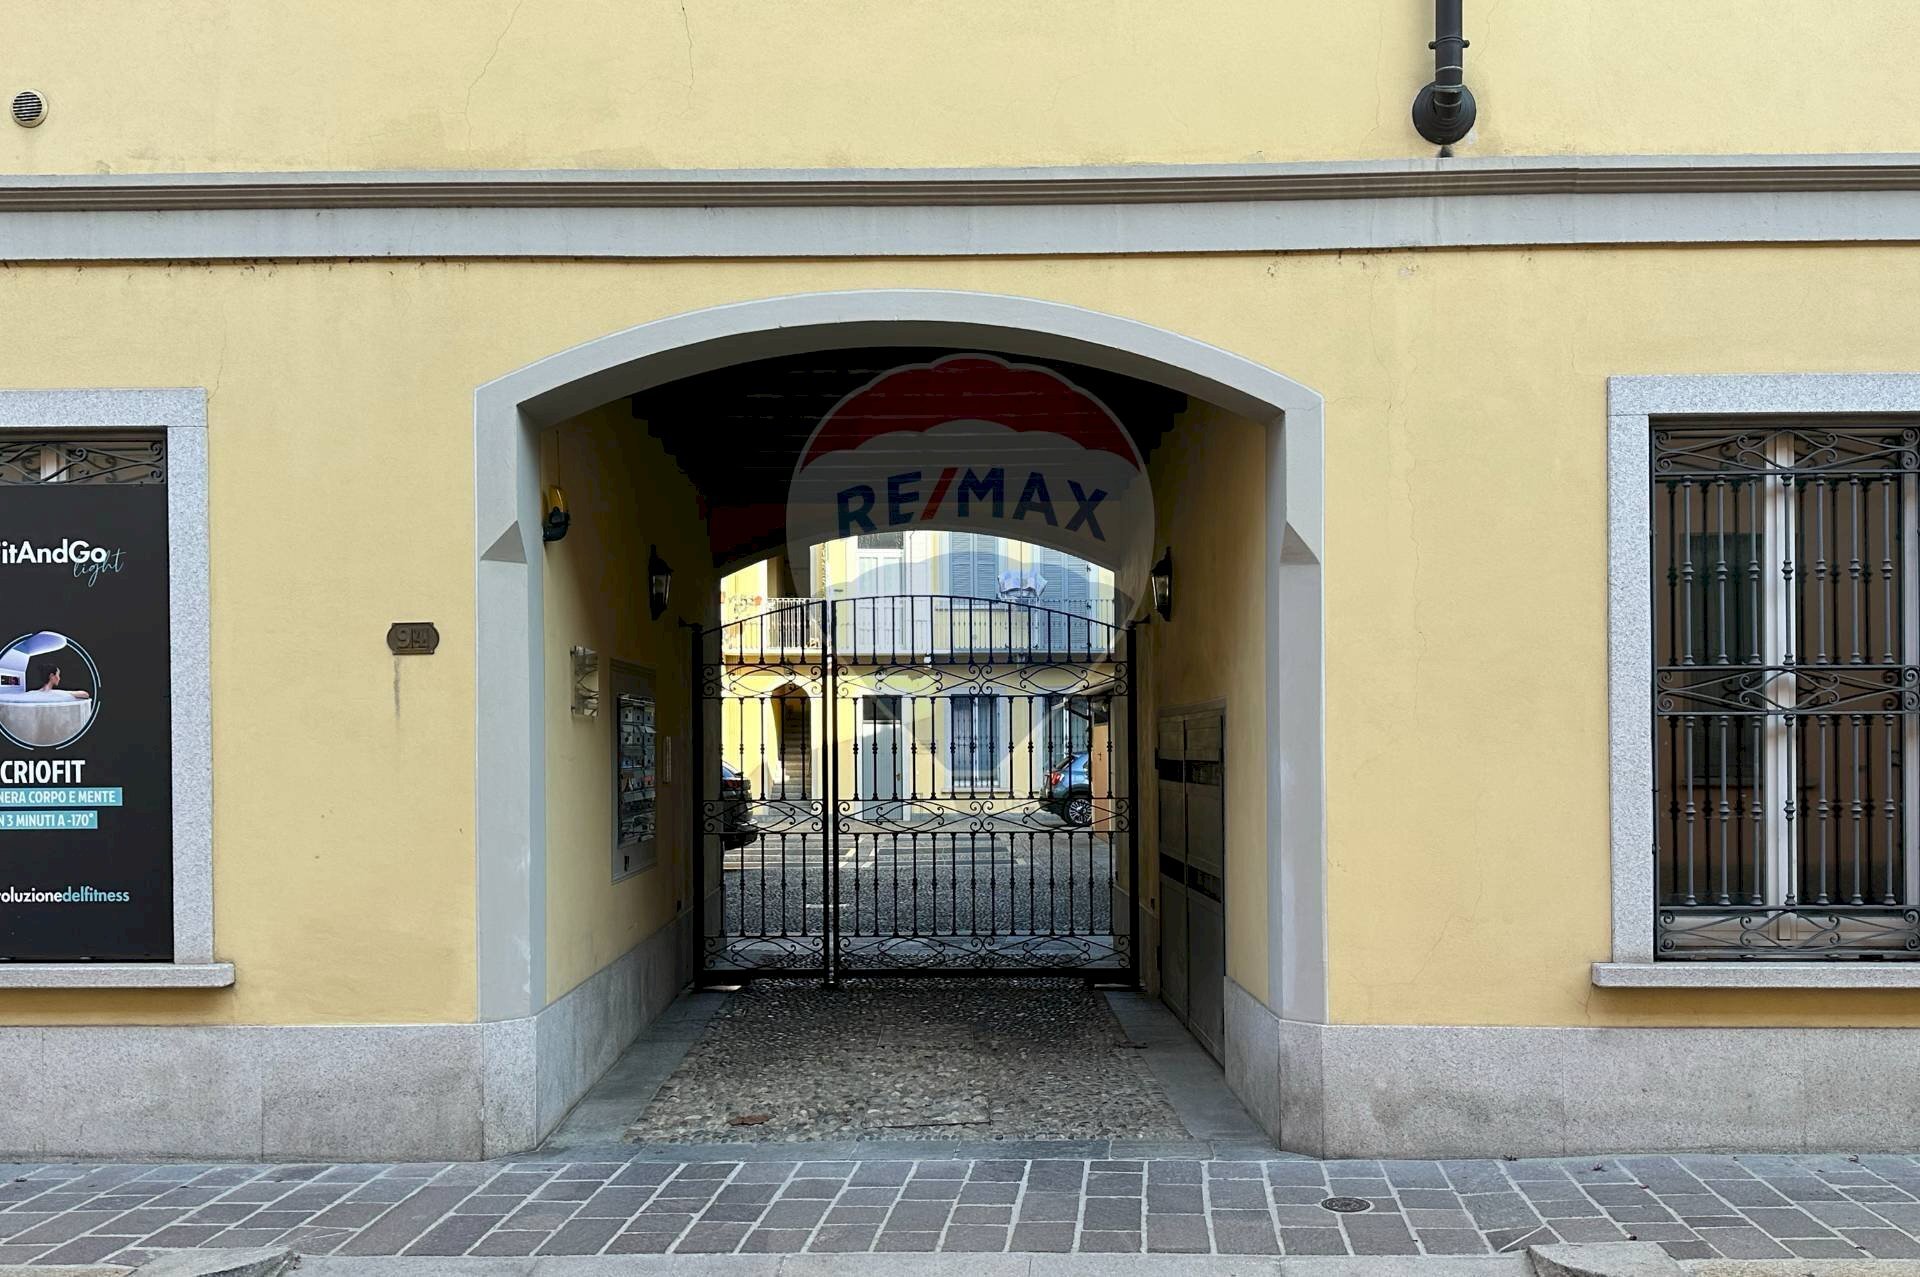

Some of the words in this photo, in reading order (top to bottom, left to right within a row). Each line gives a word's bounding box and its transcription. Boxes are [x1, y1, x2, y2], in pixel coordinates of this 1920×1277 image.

[0, 538, 108, 564] itAndGo
[73, 547, 127, 588] light
[0, 759, 86, 784] CRIOFIT
[28, 790, 67, 803] CORPO
[68, 790, 77, 803] E
[78, 790, 117, 803] MENTE
[6, 814, 14, 827] 3
[15, 814, 56, 827] MINUTI
[57, 814, 66, 827] A
